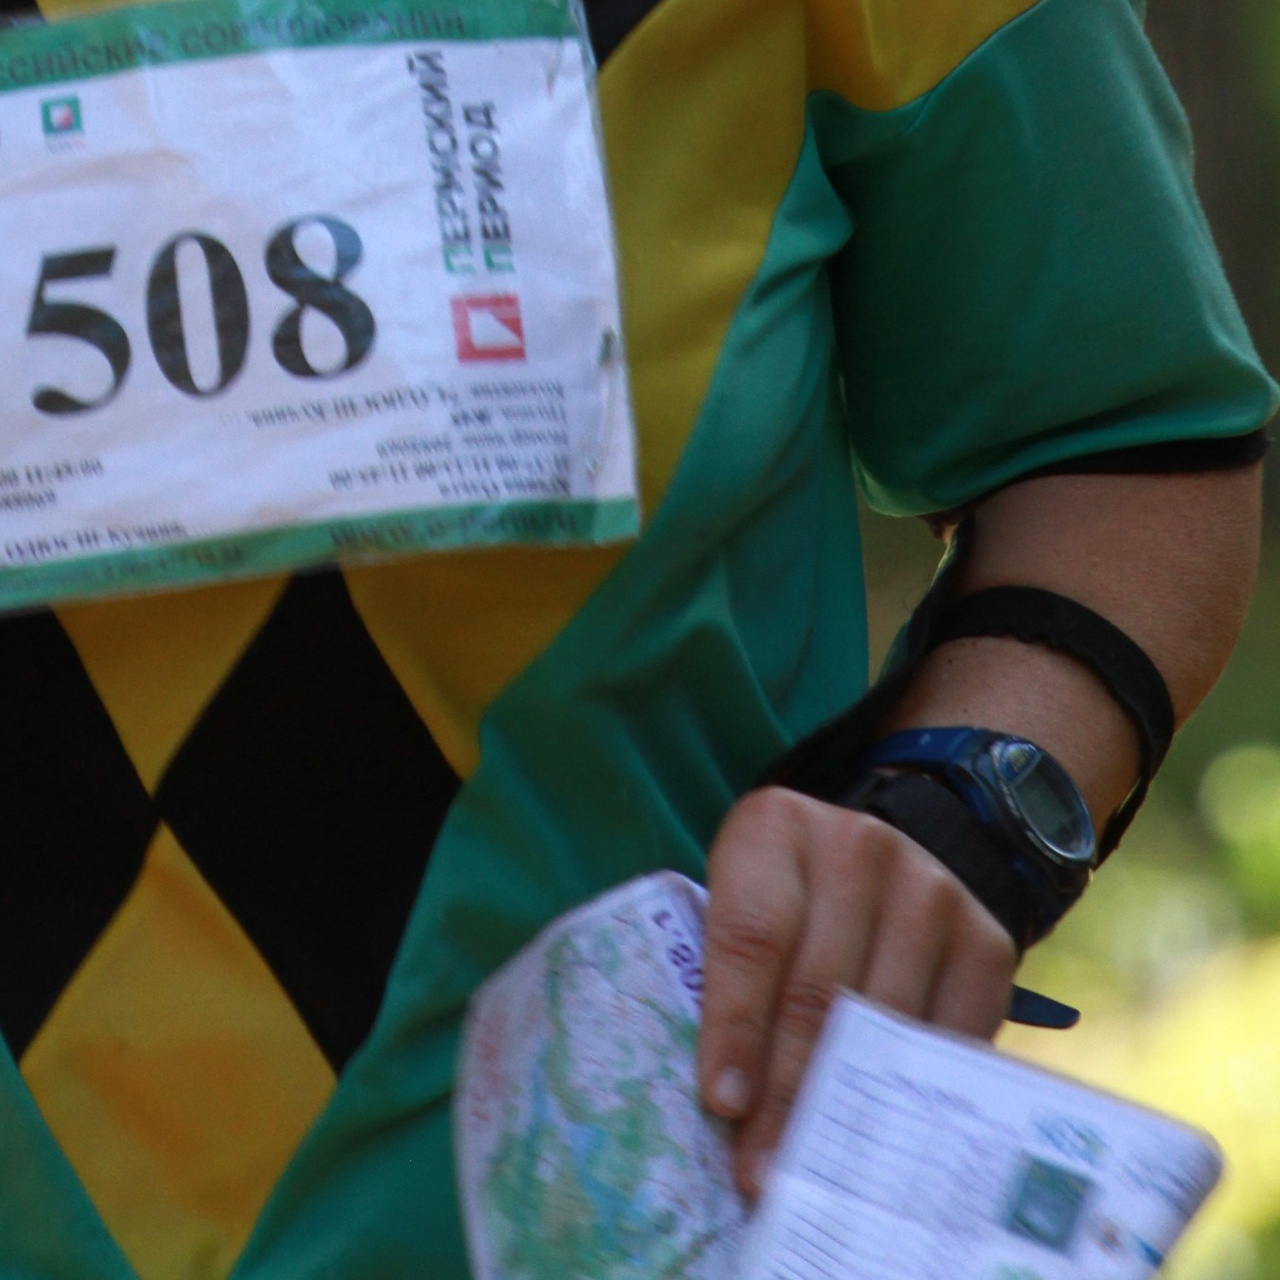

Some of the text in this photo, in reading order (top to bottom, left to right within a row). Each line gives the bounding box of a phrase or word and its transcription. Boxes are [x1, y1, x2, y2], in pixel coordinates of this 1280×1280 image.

[406, 50, 476, 274] ПЕРМСКИЙ
[462, 99, 516, 274] ПЕРИОД
[26, 213, 376, 416] 508
